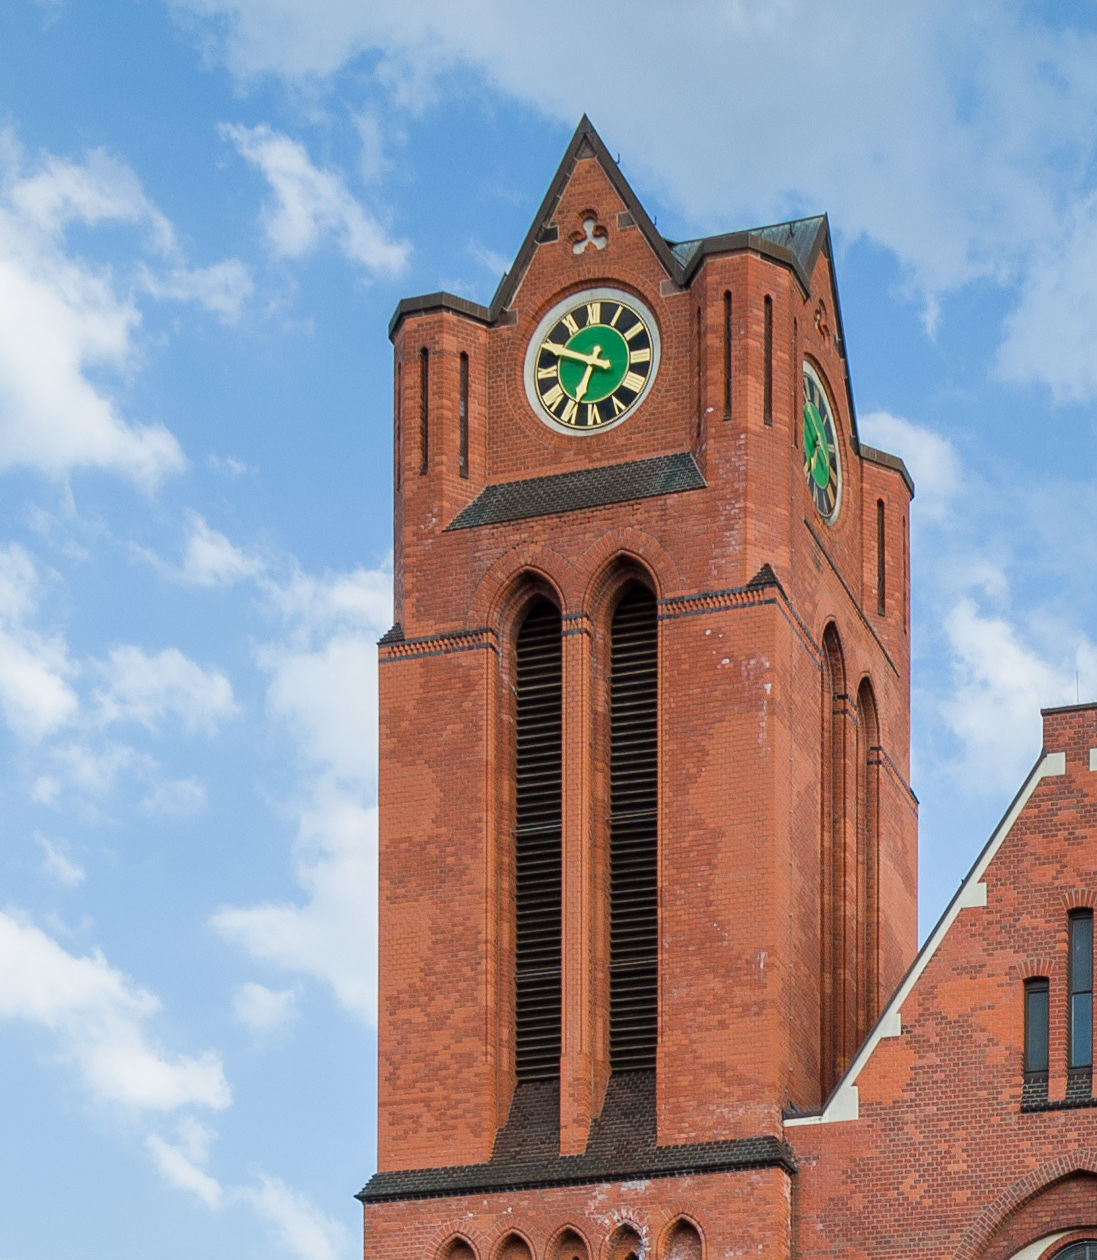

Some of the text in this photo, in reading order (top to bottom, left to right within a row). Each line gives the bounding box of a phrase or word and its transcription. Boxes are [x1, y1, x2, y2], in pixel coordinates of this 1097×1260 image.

[586, 302, 600, 326] XII
[623, 321, 644, 341] II
[630, 348, 650, 364] III
